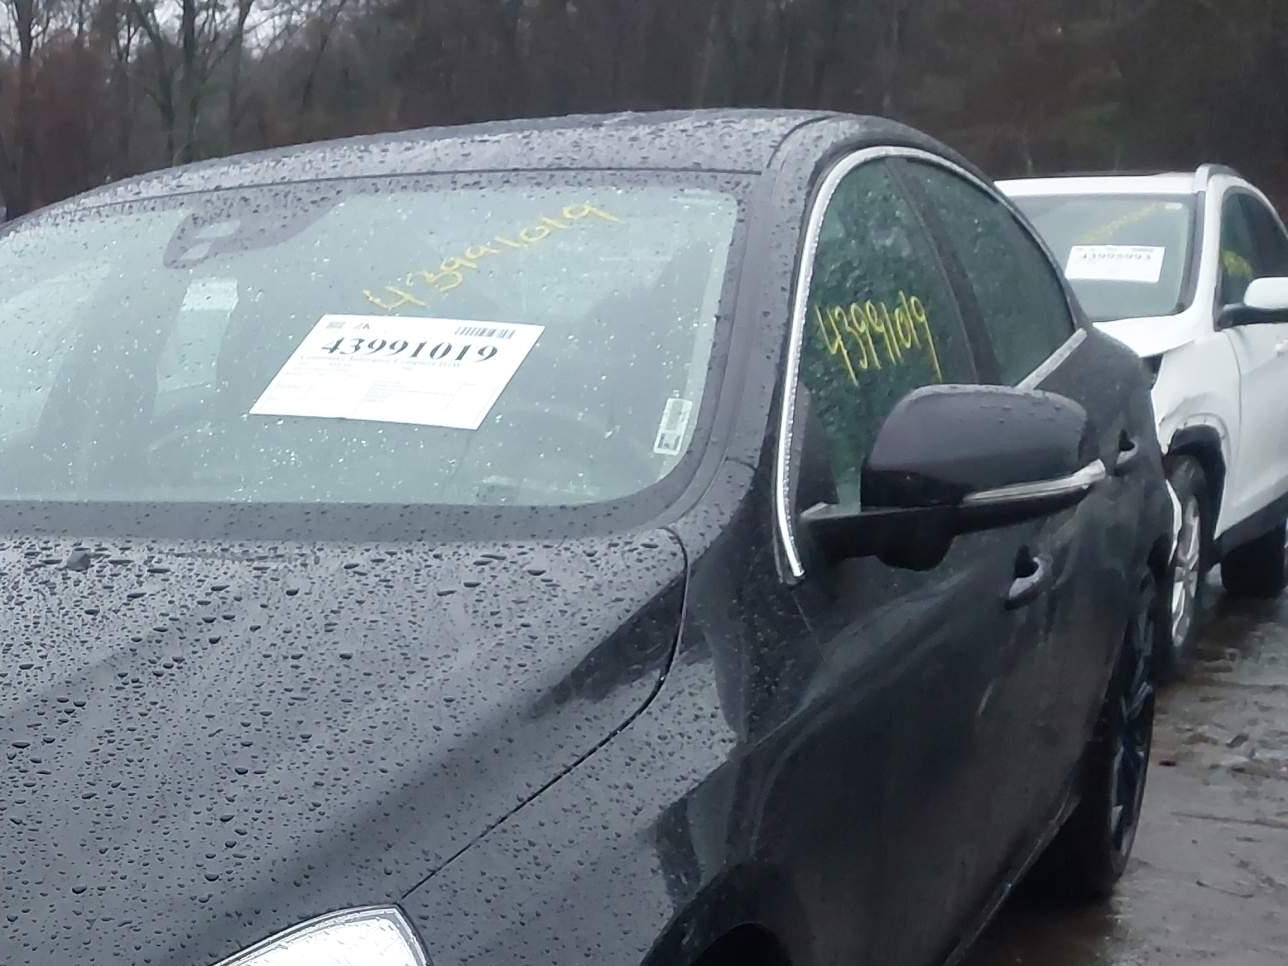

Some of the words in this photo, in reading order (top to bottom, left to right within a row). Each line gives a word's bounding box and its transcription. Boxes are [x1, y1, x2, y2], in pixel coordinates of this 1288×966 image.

[363, 200, 626, 310] 43991019
[321, 336, 499, 363] 43991019
[814, 290, 942, 387] 43991019
